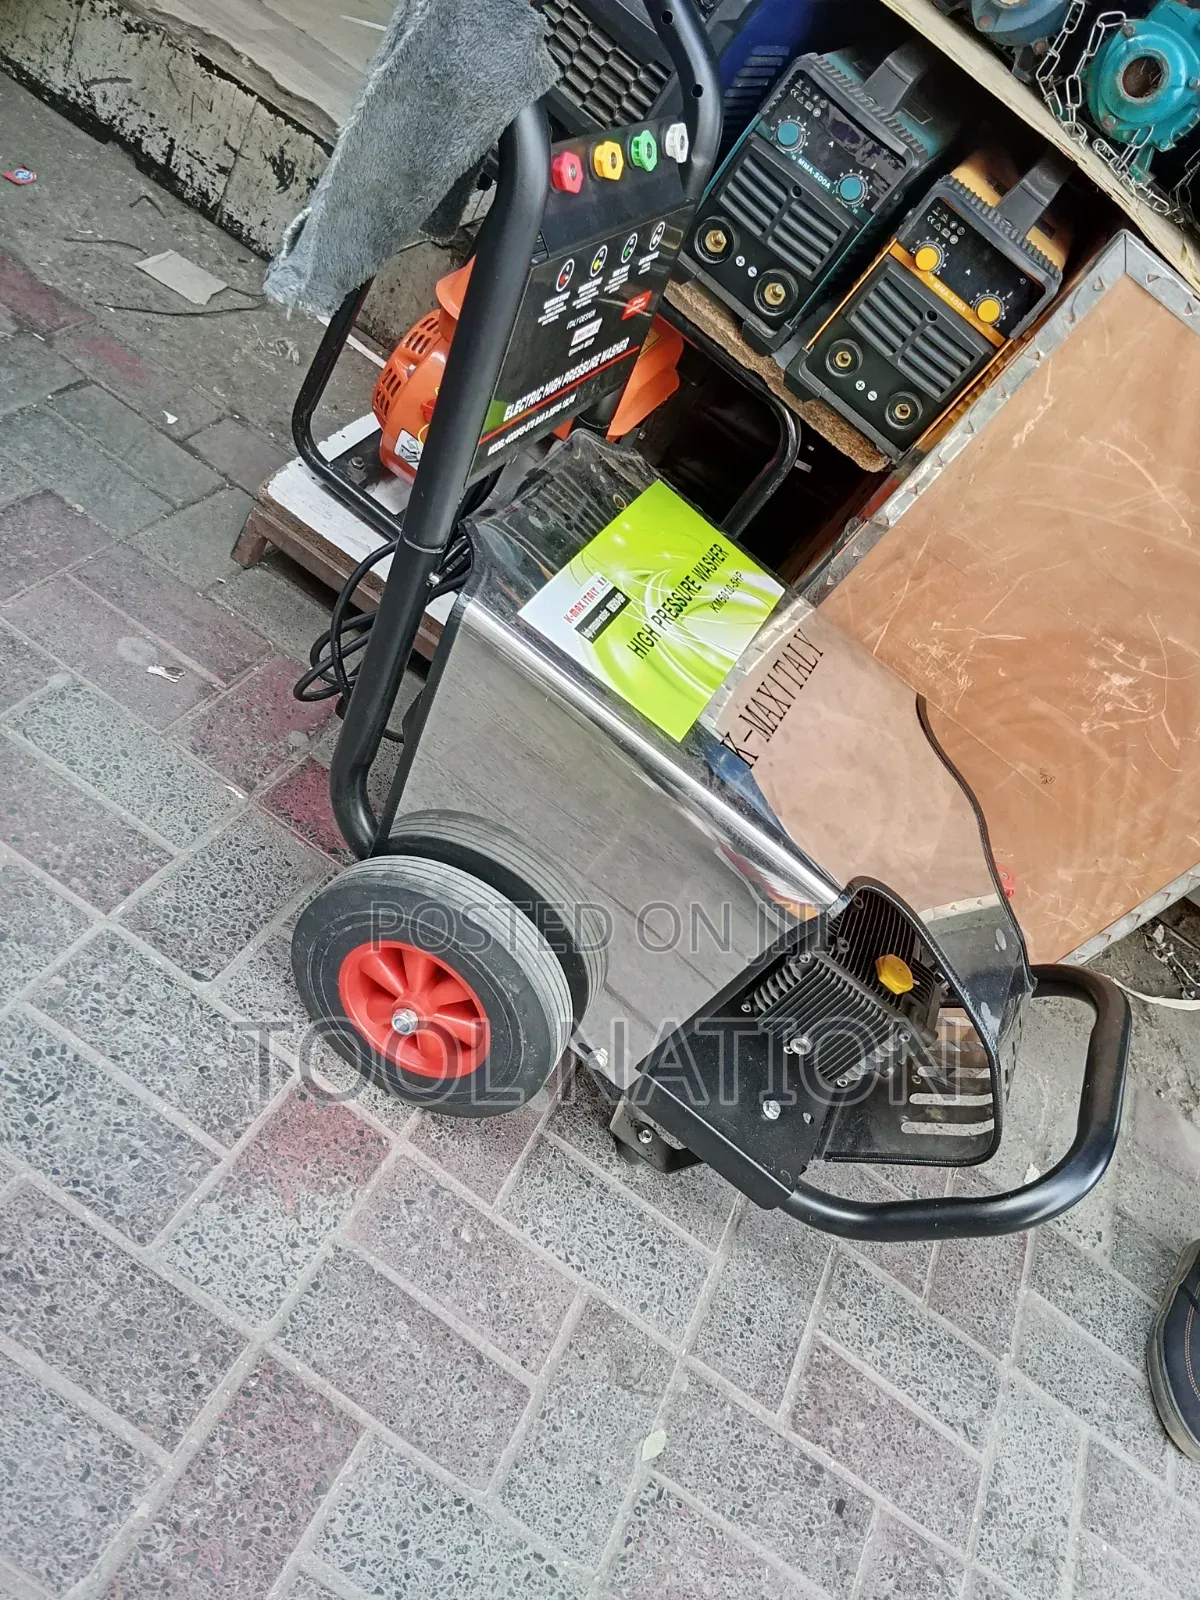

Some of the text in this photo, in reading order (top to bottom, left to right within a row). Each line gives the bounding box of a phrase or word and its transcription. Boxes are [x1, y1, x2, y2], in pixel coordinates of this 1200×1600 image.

[798, 158, 831, 189] MMA-500A
[503, 386, 545, 422] ELECTRIC
[542, 375, 564, 398] HIGH
[562, 353, 602, 386] PRESSURE
[600, 337, 630, 365] WASHER
[626, 543, 730, 660] HIGH PRESSURE WASHER
